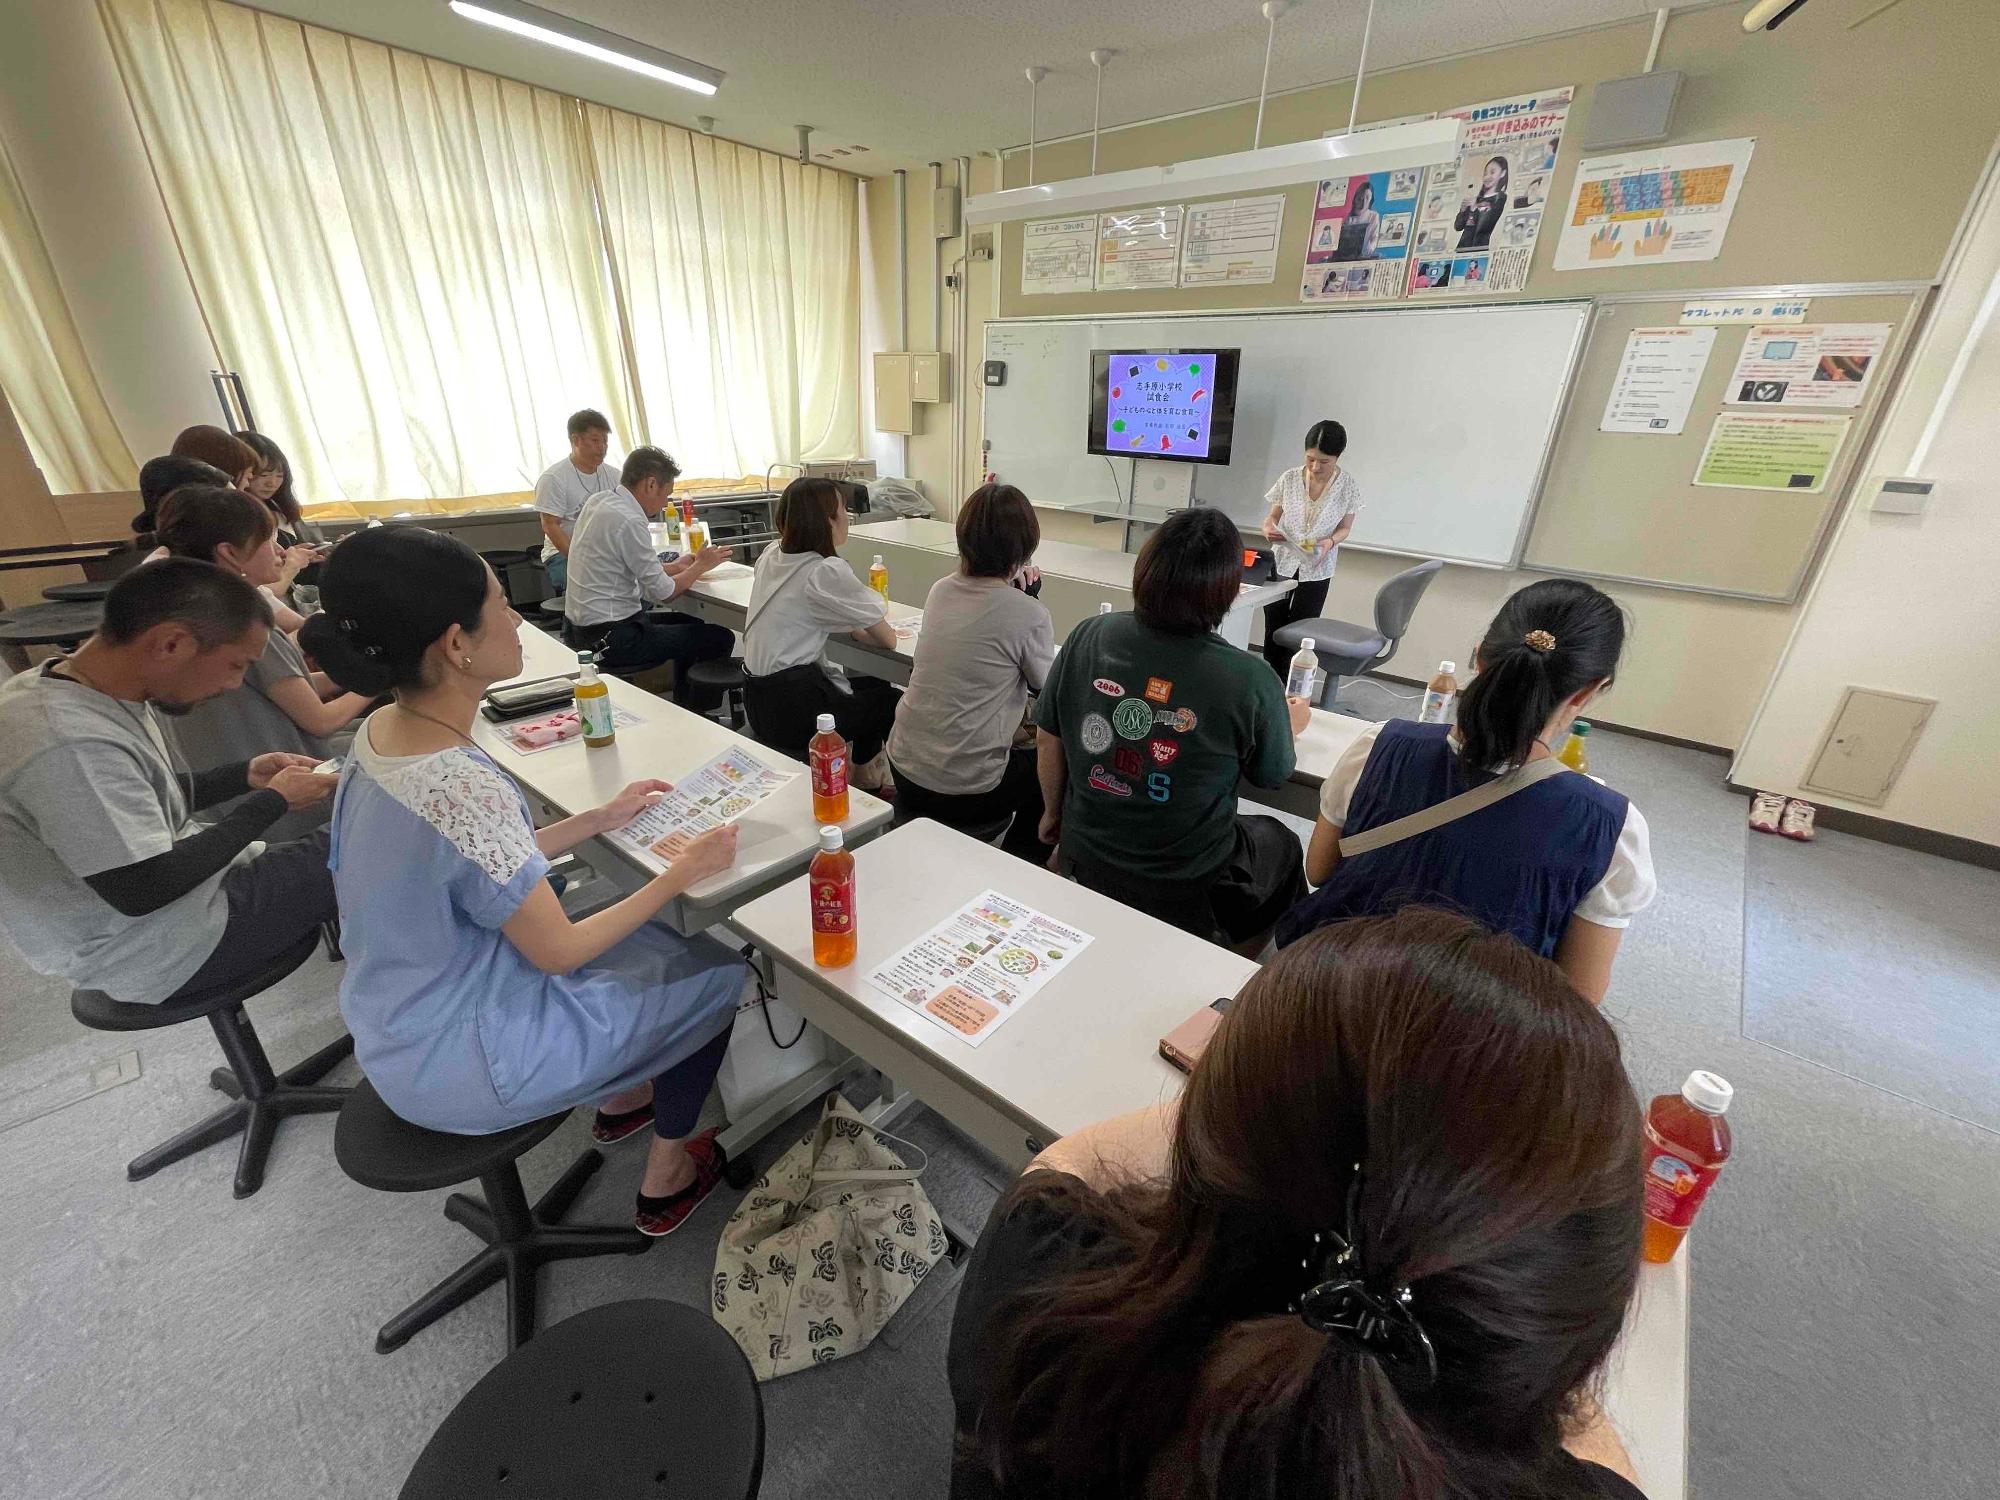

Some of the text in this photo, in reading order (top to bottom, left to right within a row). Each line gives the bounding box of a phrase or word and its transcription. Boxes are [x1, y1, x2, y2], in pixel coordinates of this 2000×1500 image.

[1136, 382, 1183, 391] 志手原小学校
[1146, 392, 1170, 402] 試食会
[1097, 681, 1120, 694] 2006
[1153, 742, 1177, 754] Natty
[1147, 771, 1171, 802] S
